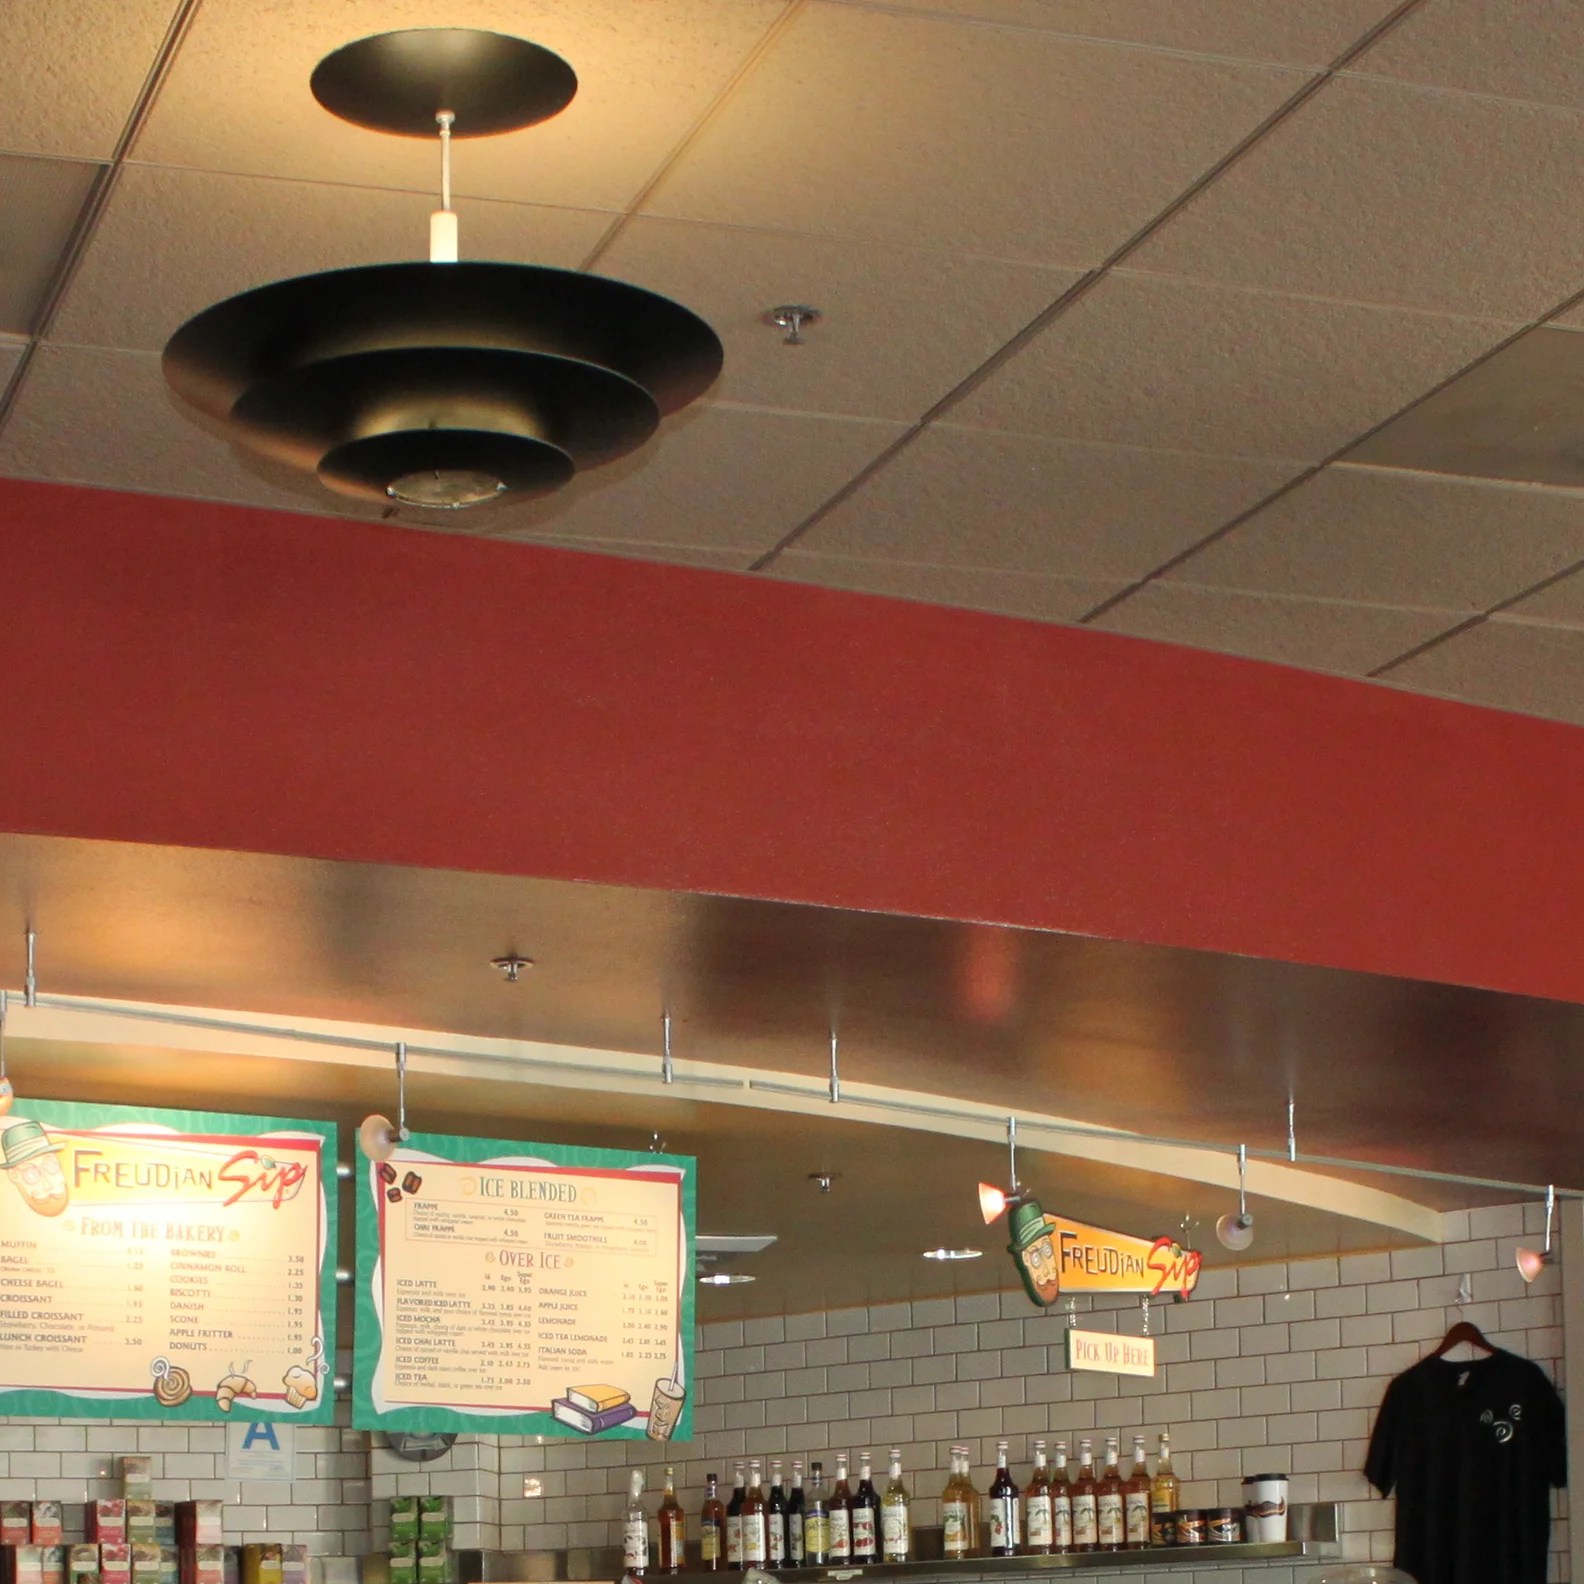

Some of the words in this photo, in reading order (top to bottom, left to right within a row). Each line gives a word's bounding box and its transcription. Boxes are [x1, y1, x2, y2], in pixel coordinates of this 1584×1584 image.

[219, 1151, 308, 1210] Sip
[480, 1176, 504, 1198] ICE
[511, 1180, 577, 1202] BLENDED
[81, 1217, 123, 1236] FROM
[132, 1221, 158, 1239] THE
[167, 1223, 226, 1242] BAKERY
[544, 1232, 564, 1240] FRUIT
[1, 1241, 37, 1249] MUFFIN
[0, 1256, 28, 1264] BAGEL
[499, 1249, 534, 1267] OVER
[540, 1252, 560, 1269] ICE
[171, 1263, 222, 1272] CINNAMON
[225, 1265, 246, 1273] ROLL
[1147, 1236, 1203, 1300] Sip
[0, 1279, 32, 1287] CHEESE
[36, 1280, 63, 1288] BAGEL
[170, 1276, 208, 1284] COOKIES
[397, 1279, 413, 1287] ICED
[170, 1289, 211, 1297] BISCOTTI
[0, 1294, 52, 1303] CROISSANT
[0, 1310, 28, 1319] FILLED
[31, 1312, 84, 1321] CROISSANT
[170, 1315, 199, 1323] SCONE
[539, 1317, 575, 1325] LEMONADE
[170, 1328, 195, 1336] APPLE
[198, 1330, 233, 1338] FRITTER
[35, 1335, 87, 1343] CROISSANT
[434, 1339, 455, 1347] LATTE
[169, 1342, 207, 1350] DONUTS
[1076, 1339, 1101, 1361] PICK
[1105, 1342, 1119, 1363] UP
[1124, 1343, 1148, 1365] HERE
[242, 1423, 280, 1450] A
